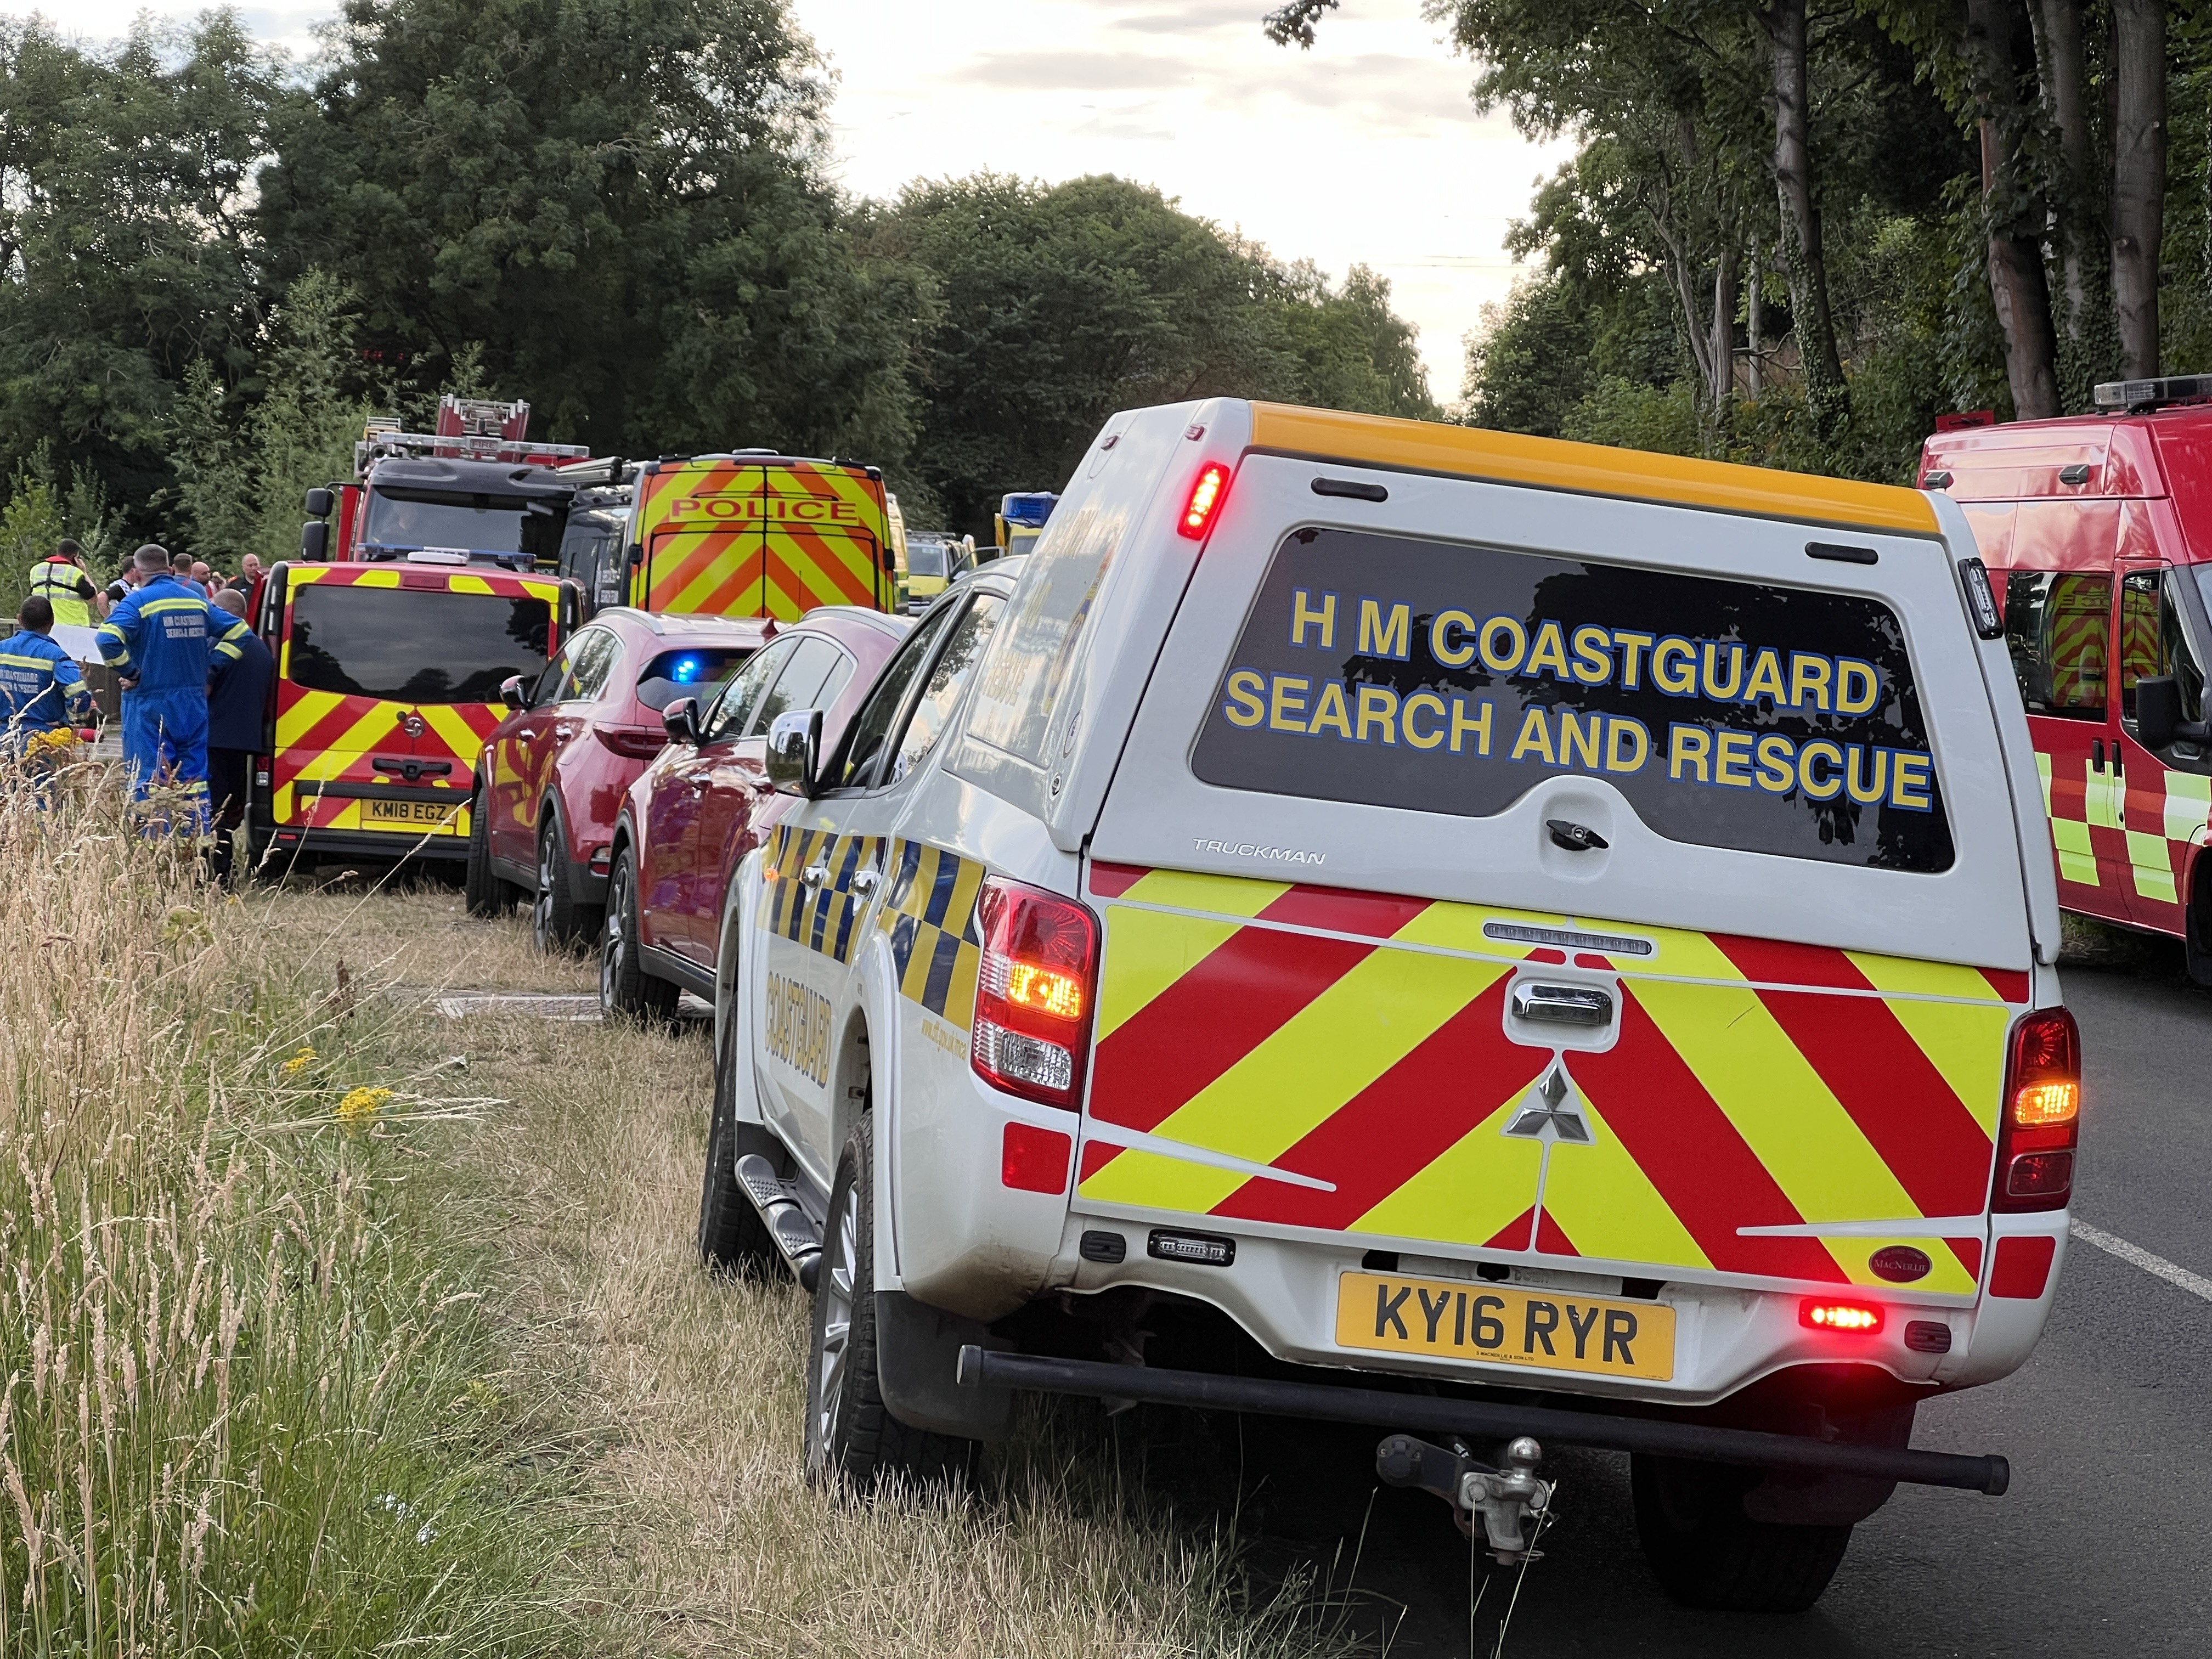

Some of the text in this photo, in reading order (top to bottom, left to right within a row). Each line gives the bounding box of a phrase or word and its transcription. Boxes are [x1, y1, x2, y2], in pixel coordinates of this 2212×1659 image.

[472, 440, 496, 449] FIRE
[672, 499, 857, 521] POLICE
[1429, 608, 1880, 716] COASTGUARD
[1224, 669, 1932, 811] SEARCH AND RESCUE
[372, 802, 447, 821] KM18 EGZ
[1193, 838, 1327, 866] TRUCKMAN
[765, 970, 832, 1090] COASTGUARD
[1375, 1284, 1638, 1365] KY16 RYR
